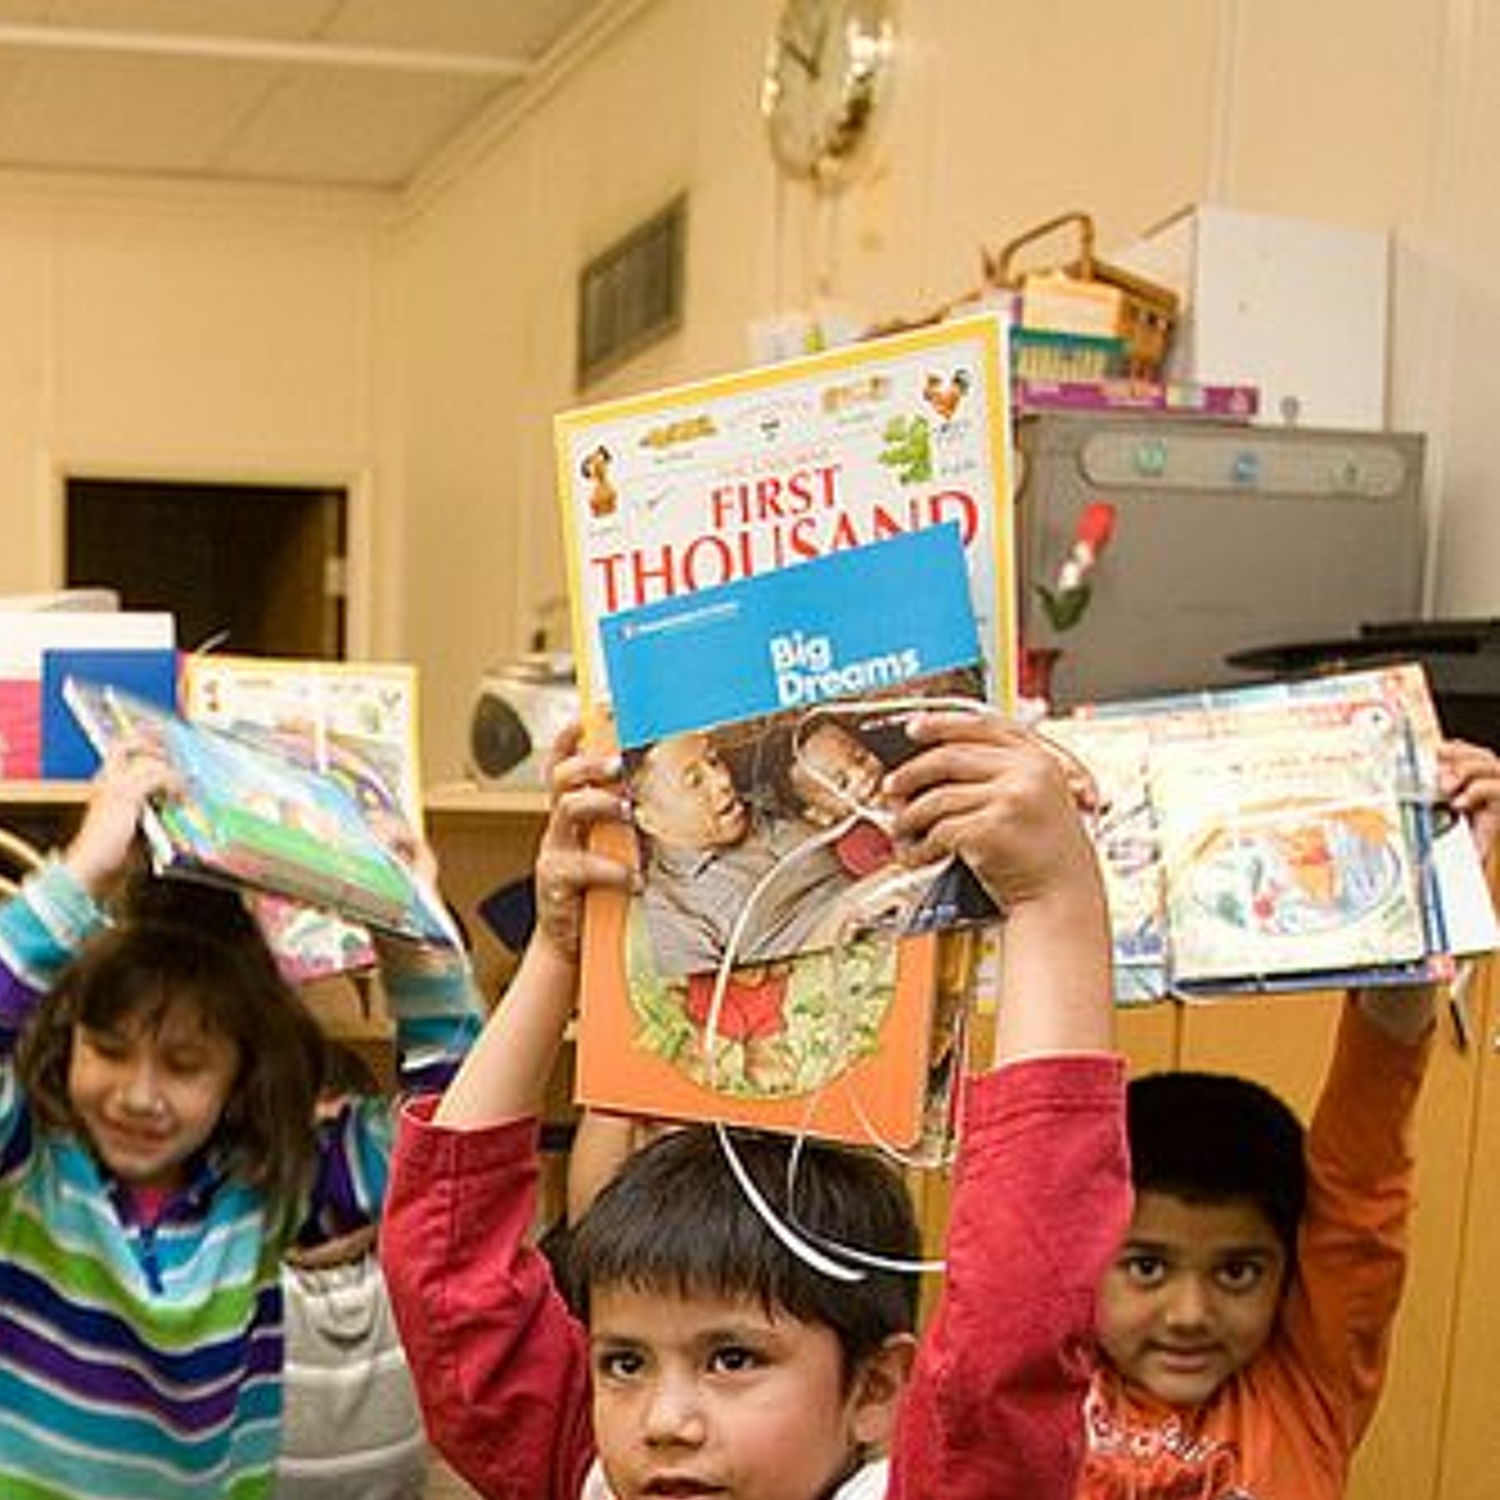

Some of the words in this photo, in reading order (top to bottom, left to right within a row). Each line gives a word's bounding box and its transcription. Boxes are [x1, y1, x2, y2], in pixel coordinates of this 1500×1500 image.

[711, 463, 842, 529] FIRST
[590, 489, 979, 613] THOUSAND
[769, 629, 832, 672] Big
[778, 647, 921, 707] Dreams
